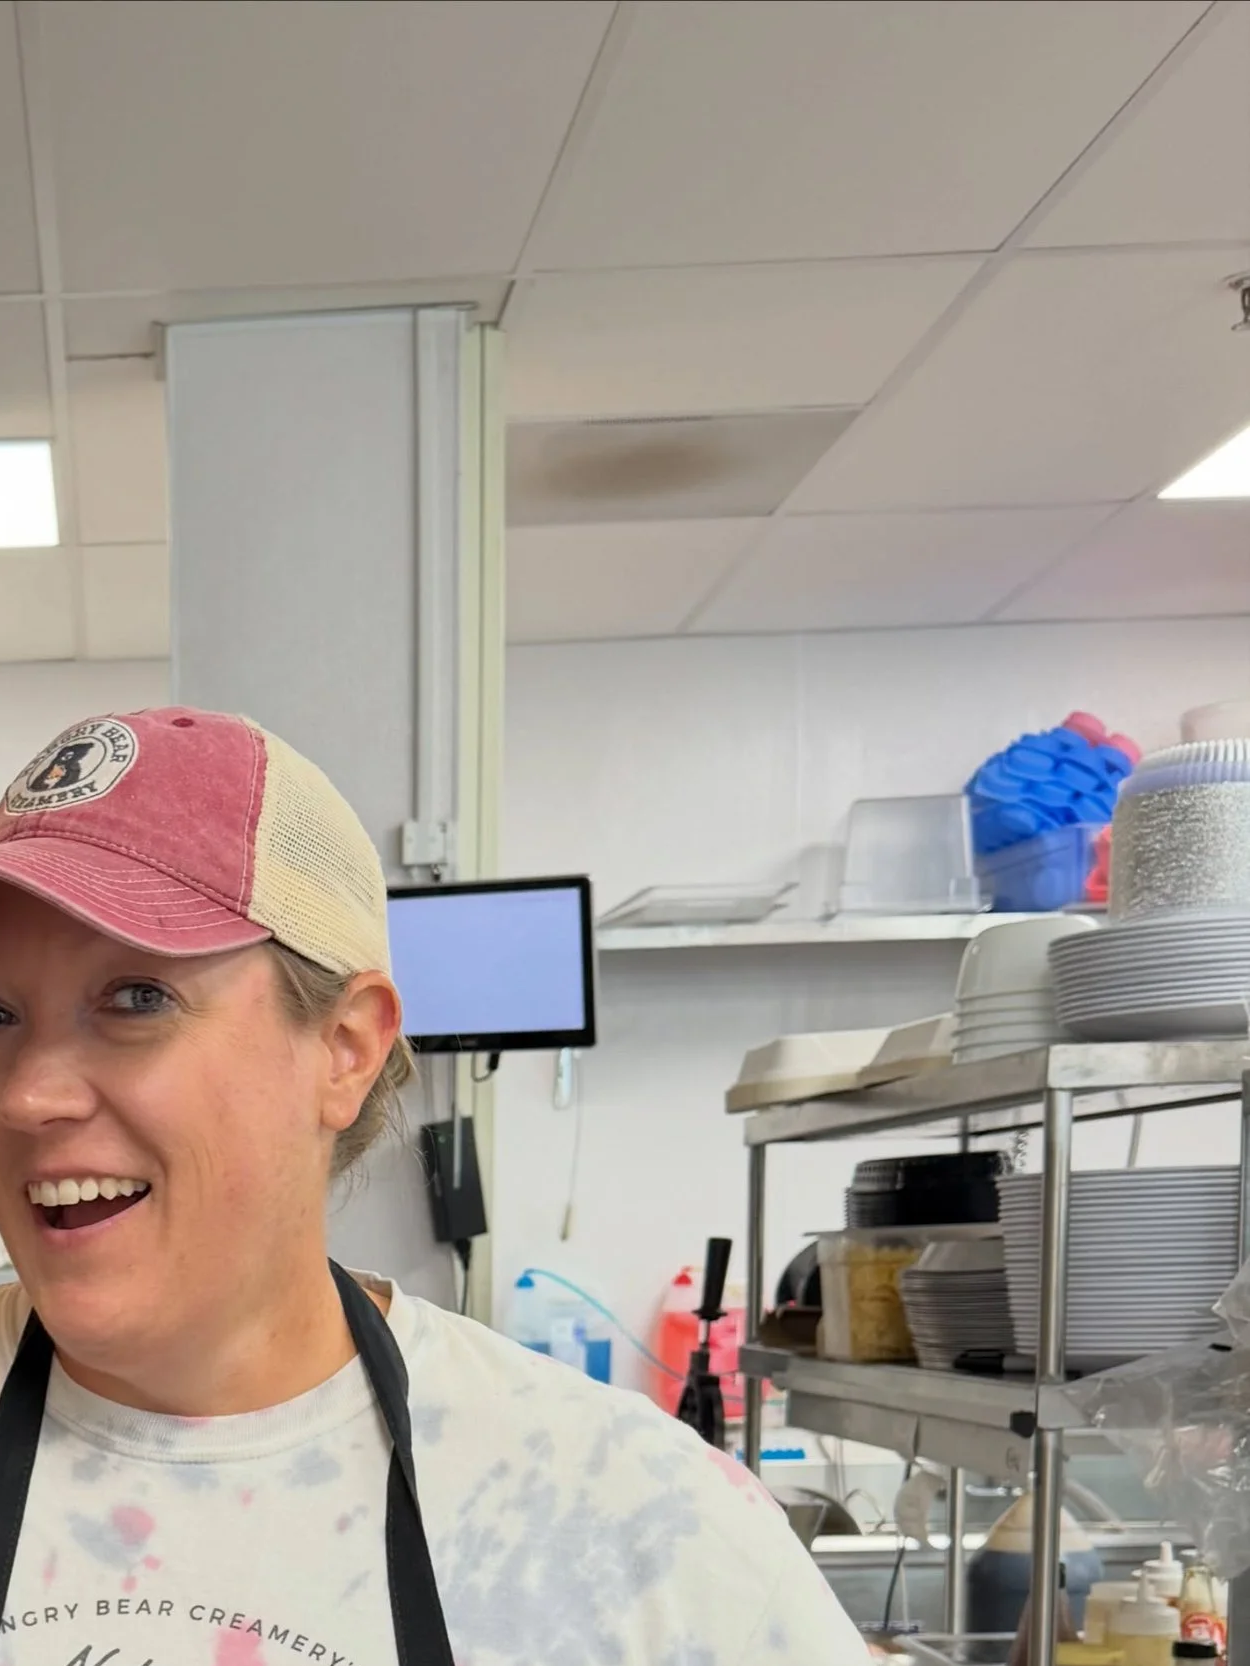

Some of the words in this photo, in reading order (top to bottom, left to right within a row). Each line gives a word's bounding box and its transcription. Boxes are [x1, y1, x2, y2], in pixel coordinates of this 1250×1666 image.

[101, 725, 128, 764] BEAR
[0, 1602, 79, 1635] NGRY
[95, 1598, 175, 1617] BEAR
